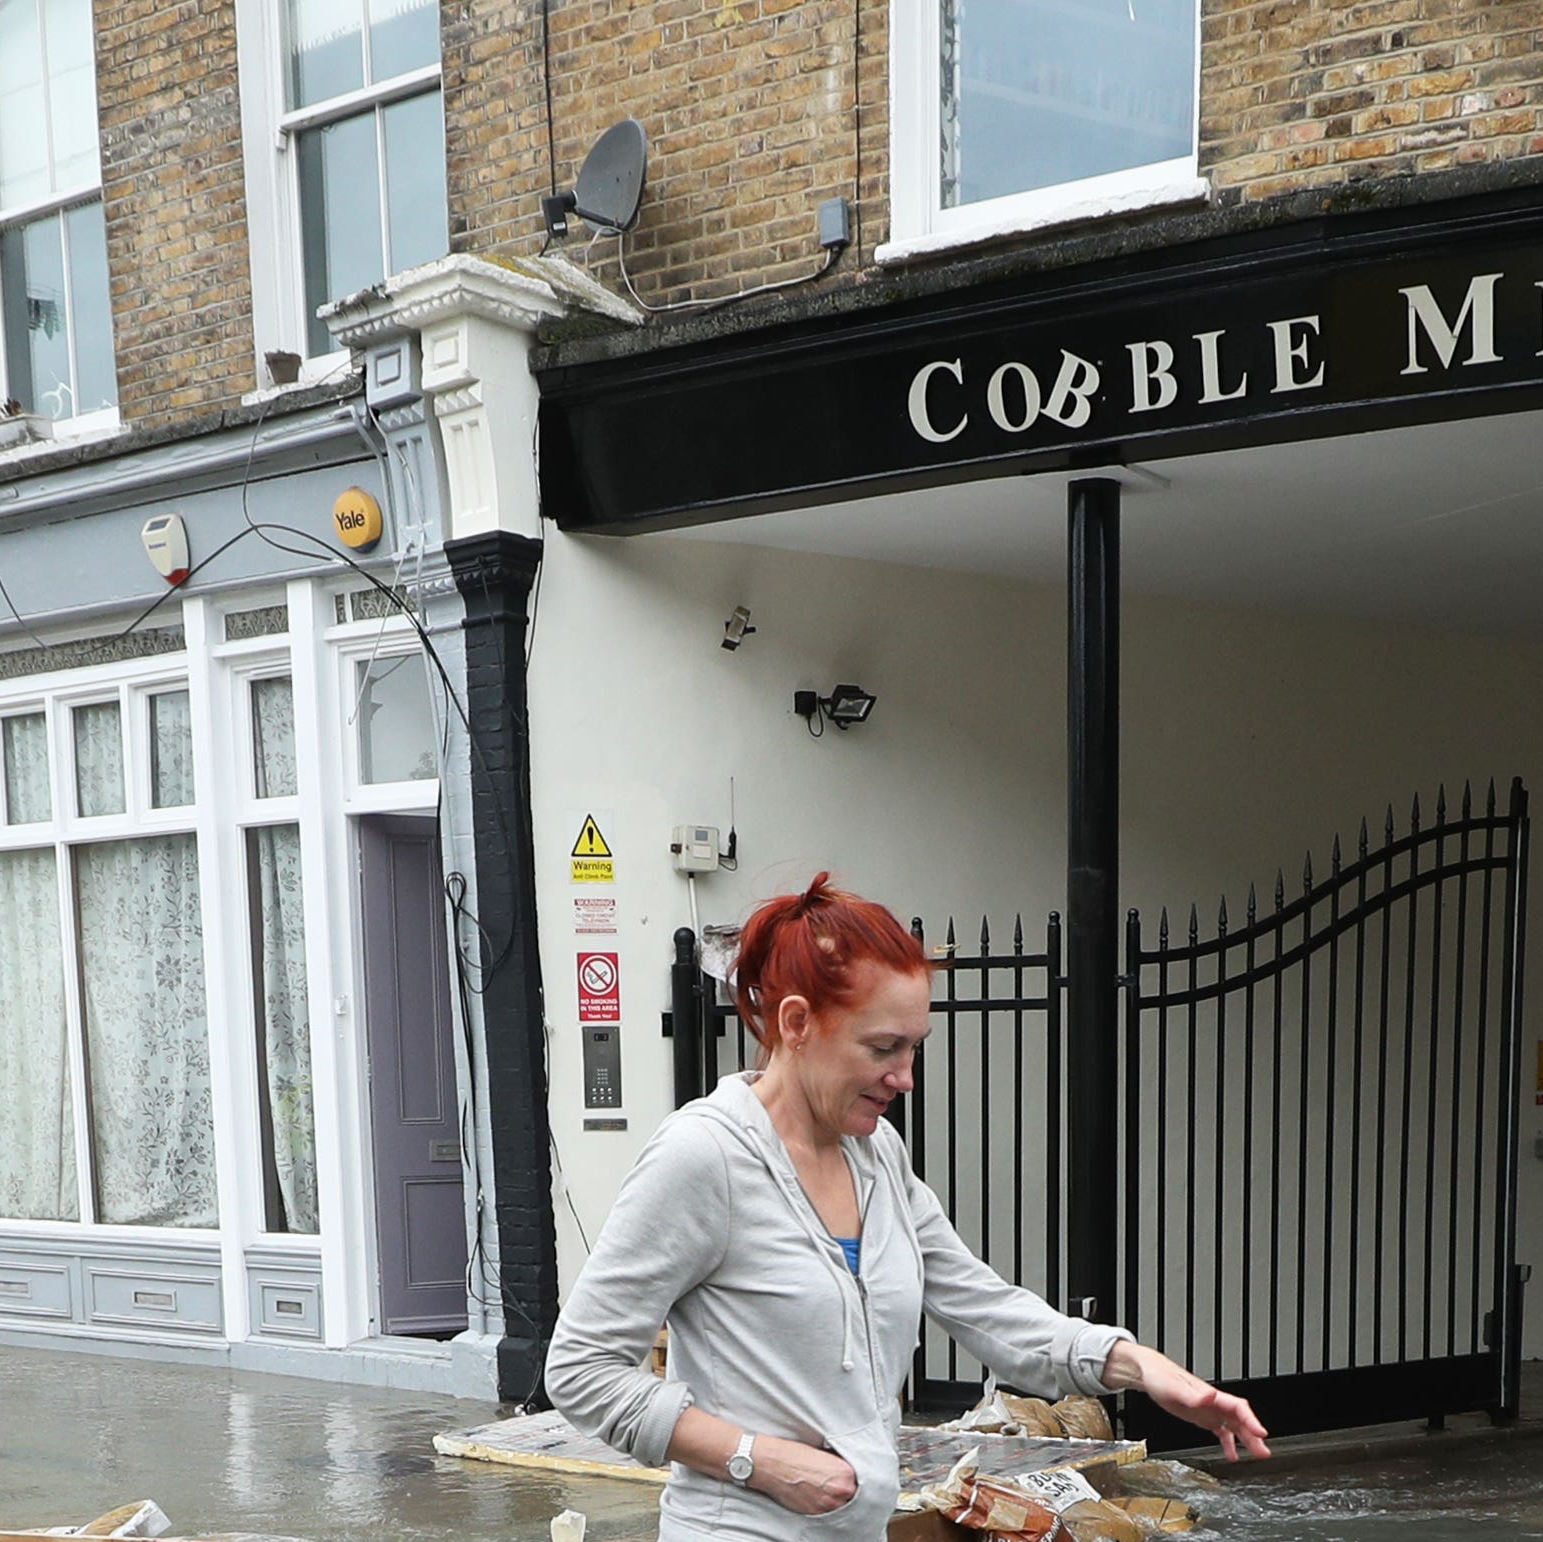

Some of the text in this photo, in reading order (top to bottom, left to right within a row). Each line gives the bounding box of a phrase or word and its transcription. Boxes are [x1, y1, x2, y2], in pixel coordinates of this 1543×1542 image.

[908, 314, 1326, 443] COBBLE
[335, 510, 365, 531] Yale
[573, 861, 612, 873] Warning
